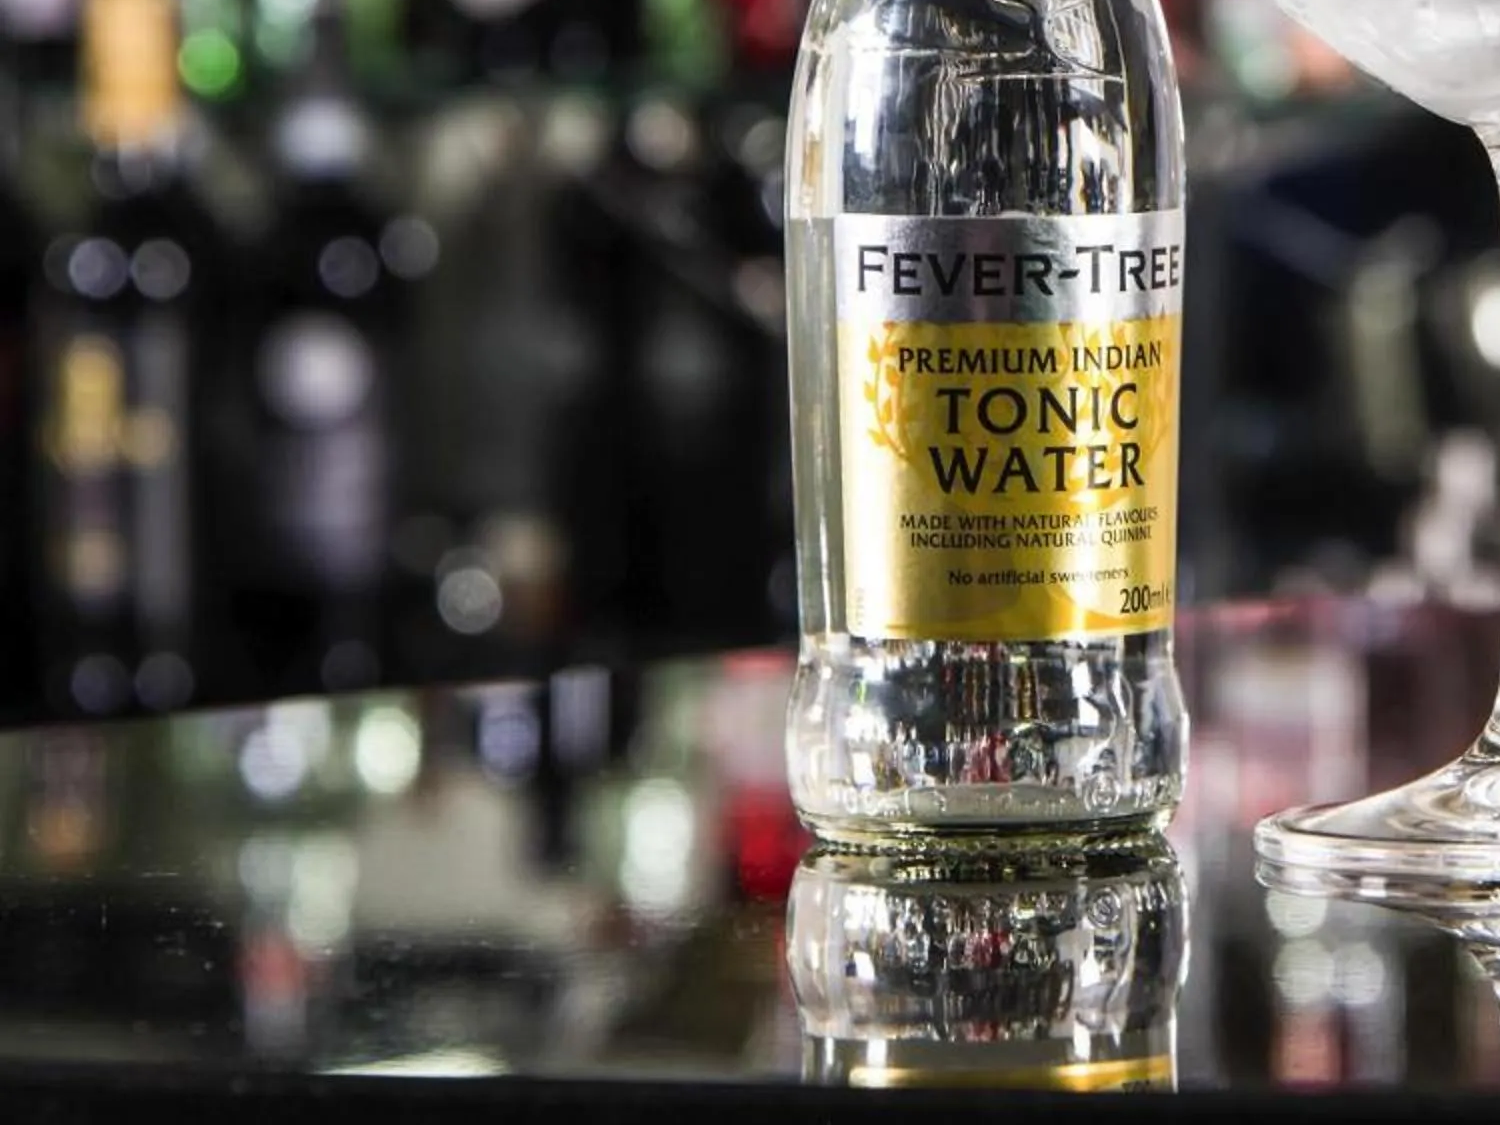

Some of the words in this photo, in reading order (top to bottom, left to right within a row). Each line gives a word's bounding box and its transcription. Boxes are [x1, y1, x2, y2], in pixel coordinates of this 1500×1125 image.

[857, 244, 1181, 296] FEVER-TREE
[898, 346, 1058, 374] PREMIUM
[1072, 341, 1162, 372] INDIAN
[935, 381, 1139, 435] TONIC
[927, 441, 1145, 494] WATER
[899, 514, 952, 530] MADE
[957, 514, 1006, 531] WITH
[910, 532, 1011, 549] INCLUDING
[948, 570, 974, 586] No
[977, 569, 1046, 586] artificial
[1049, 567, 1129, 584] sweteners
